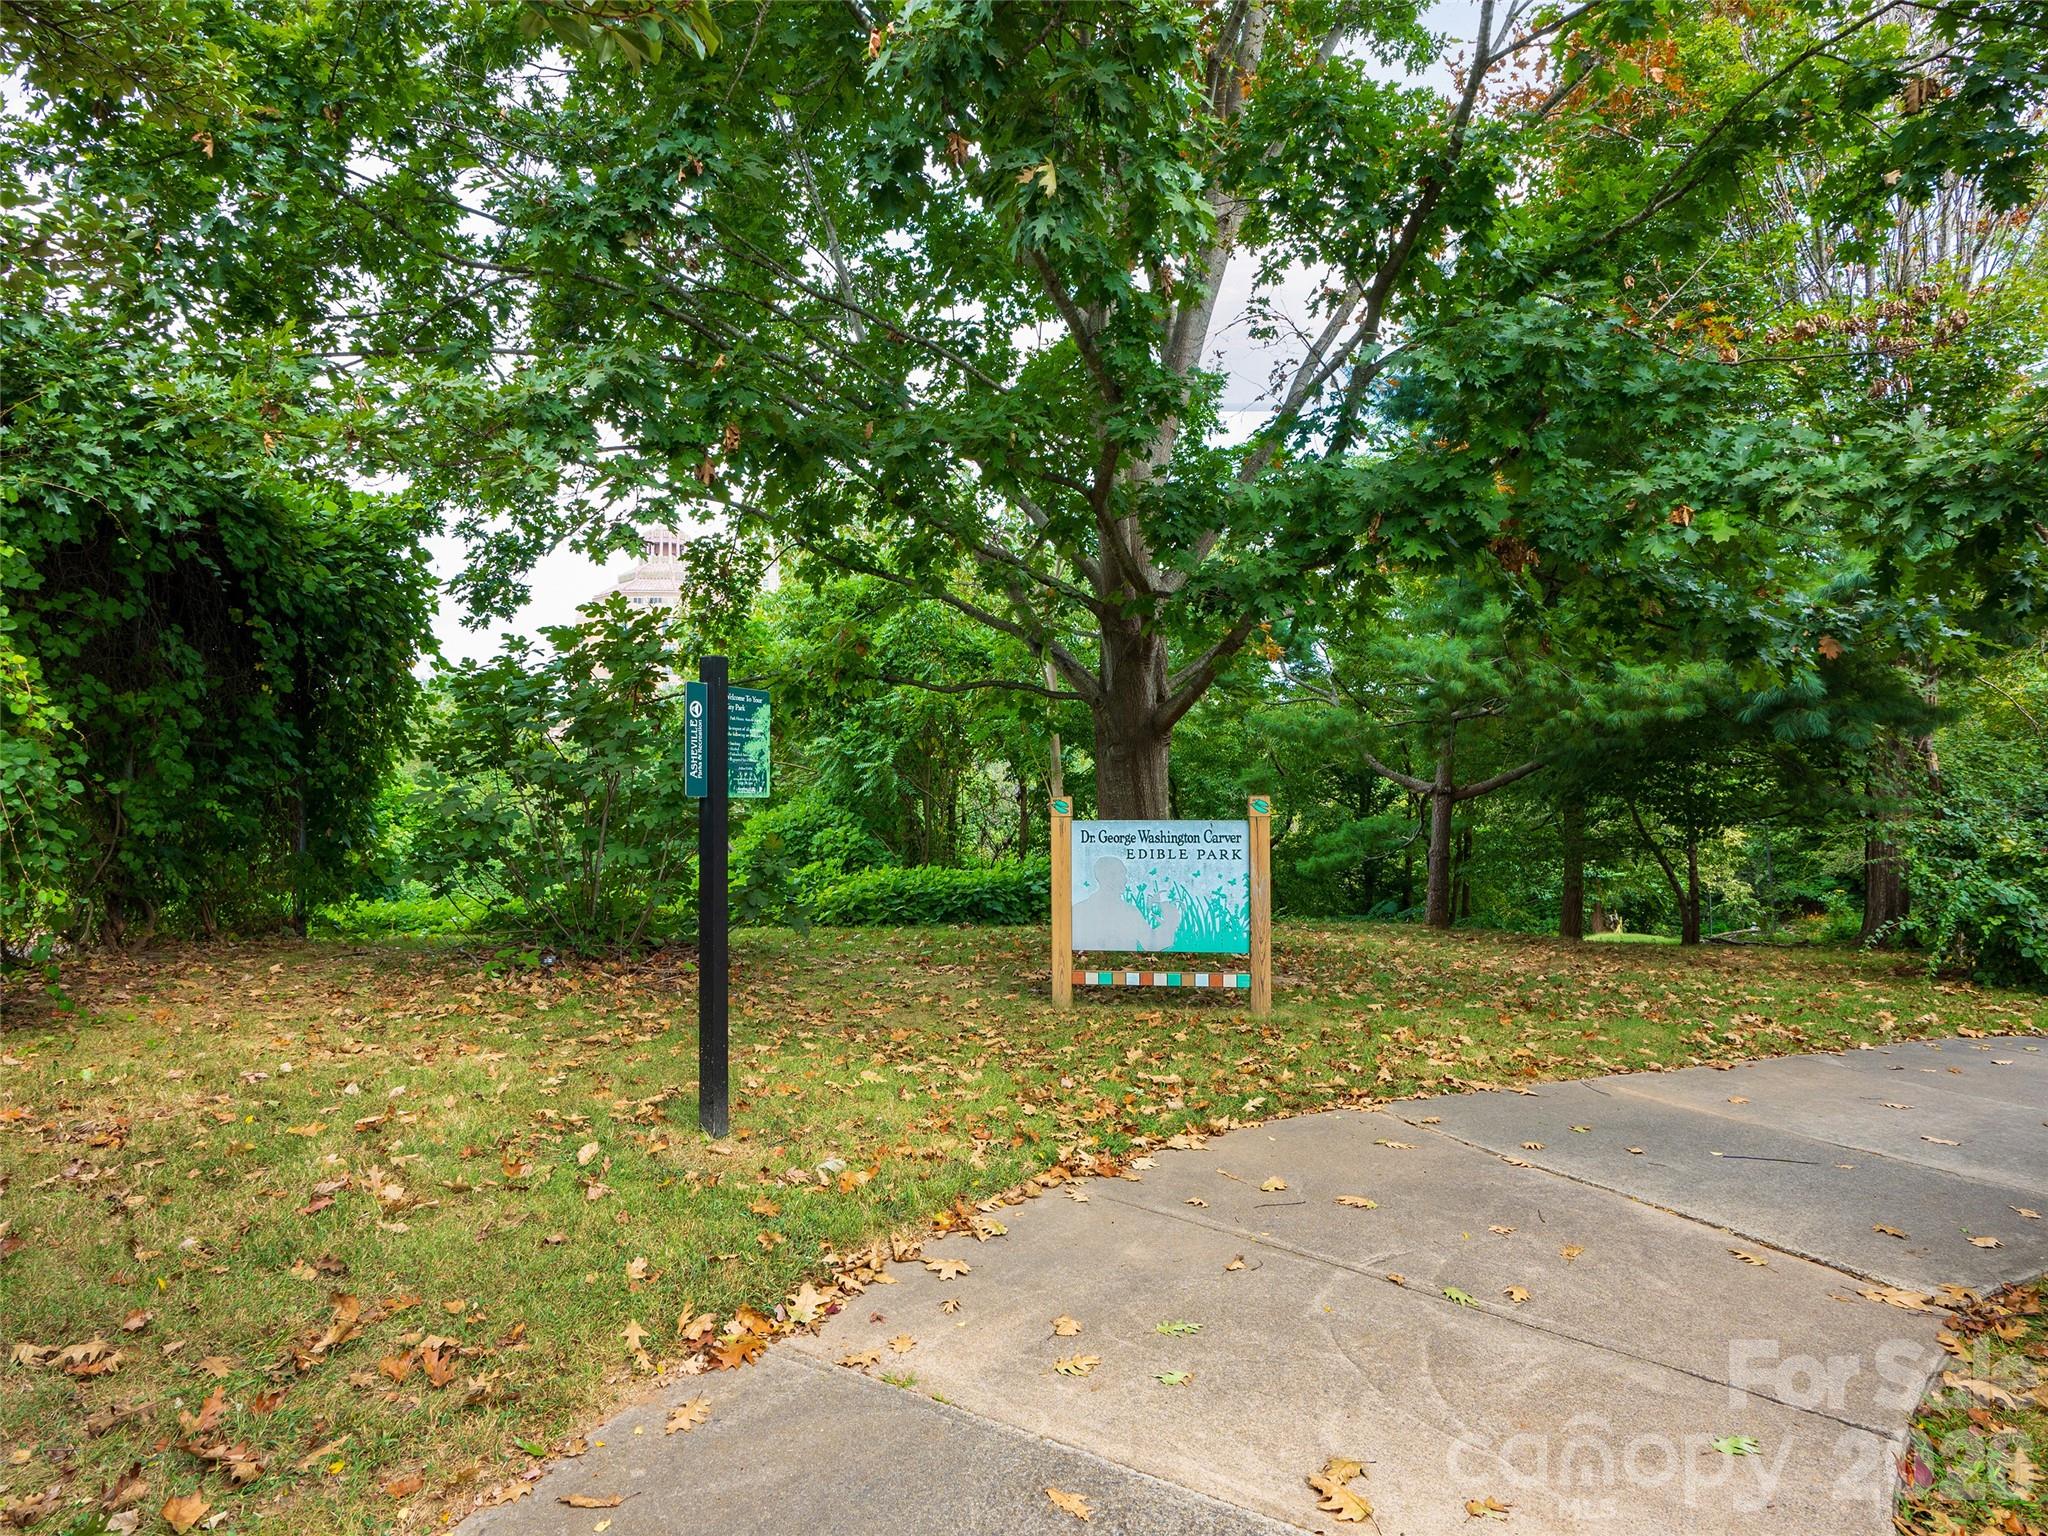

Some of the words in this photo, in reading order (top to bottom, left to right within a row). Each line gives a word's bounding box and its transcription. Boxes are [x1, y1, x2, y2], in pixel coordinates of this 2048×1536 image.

[752, 695, 762, 704] Your
[735, 704, 746, 712] Park
[689, 719, 698, 779] ASHEVILLE
[1081, 830, 1096, 844] Dr.
[1098, 830, 1137, 846] George
[1137, 830, 1201, 846] Washington
[1203, 829, 1242, 844] Carver
[1126, 849, 1189, 860] EDIBLE
[1196, 849, 1243, 860] PARK
